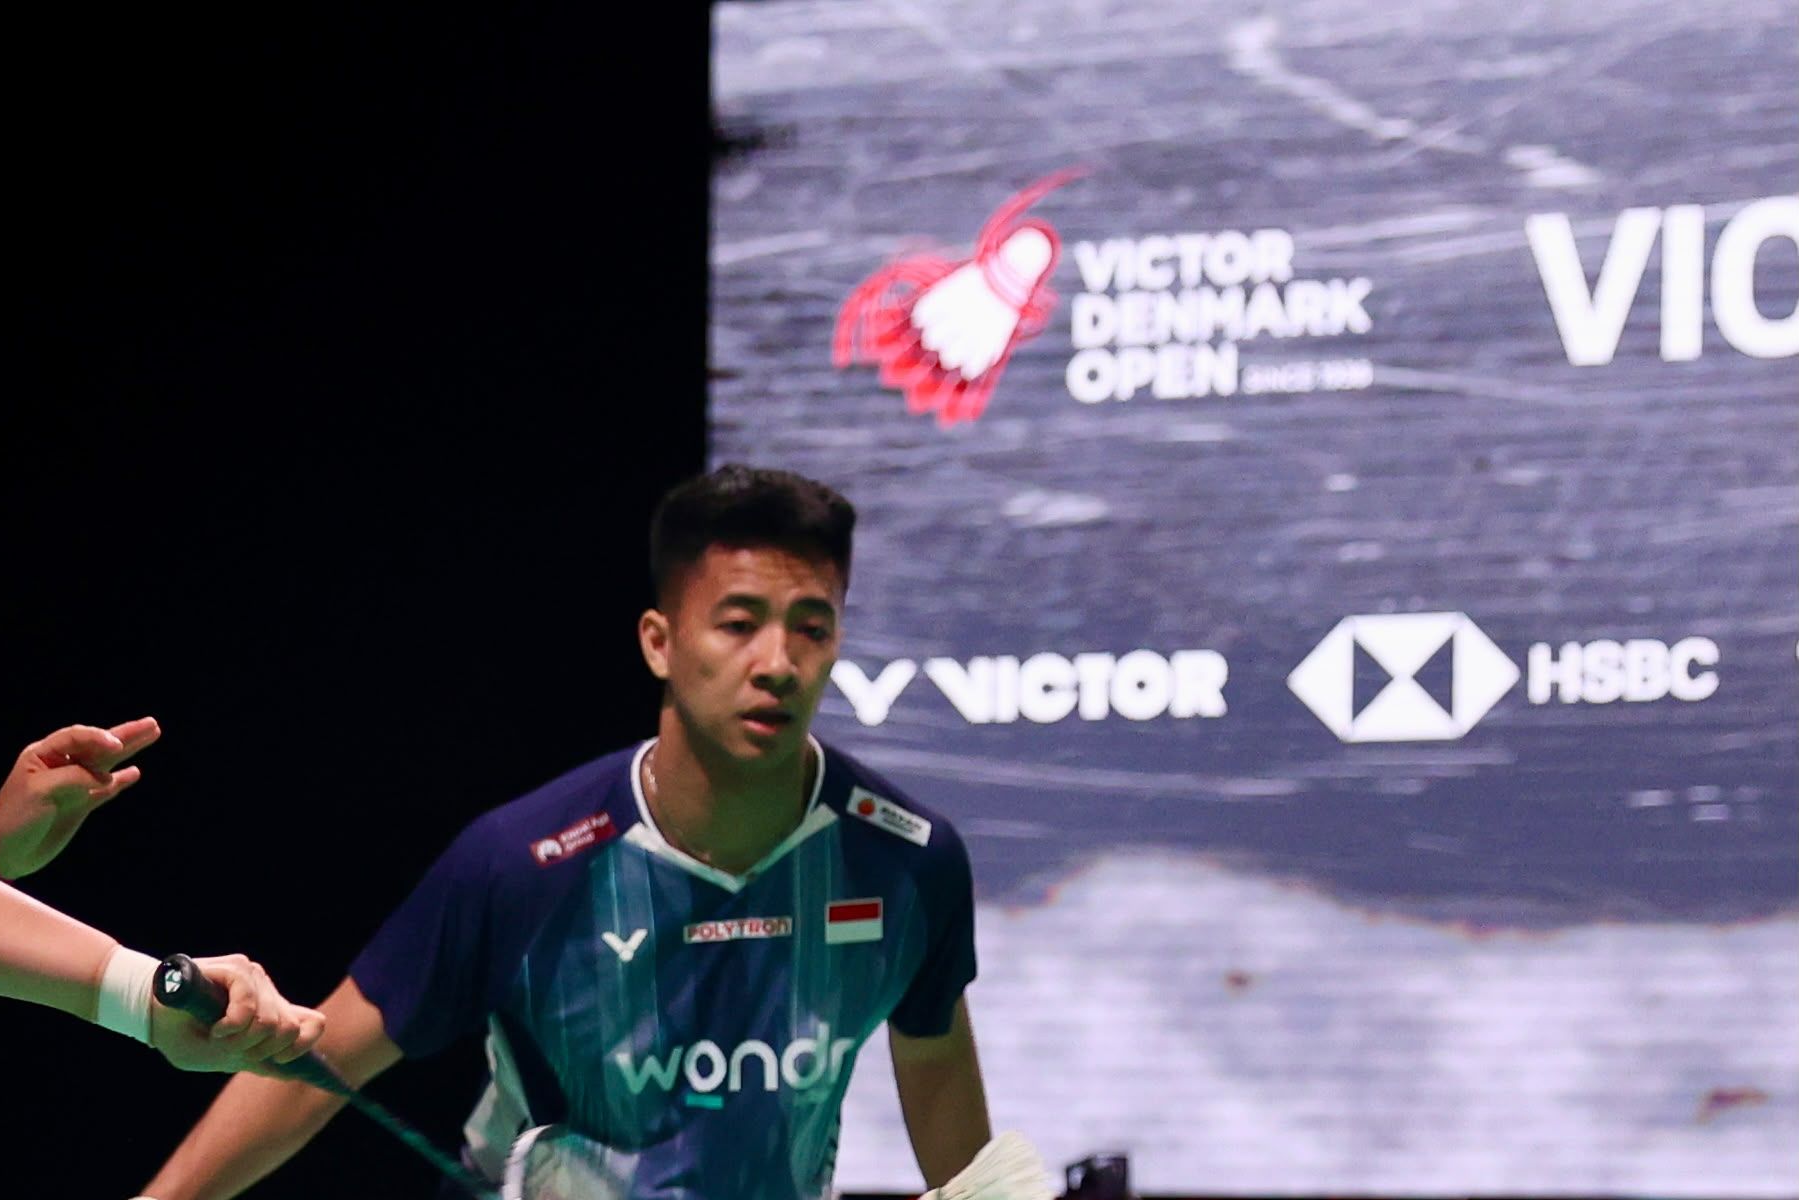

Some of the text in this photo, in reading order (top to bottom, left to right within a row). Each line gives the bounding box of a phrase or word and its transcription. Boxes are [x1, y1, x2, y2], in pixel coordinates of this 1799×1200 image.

[1074, 229, 1294, 292] VICTOR
[1070, 278, 1373, 349] DENMARK
[1065, 342, 1238, 404] OPEN
[923, 649, 1229, 724] VICTOR
[1527, 637, 1720, 704] HSBC
[615, 1021, 856, 1095] wondr
